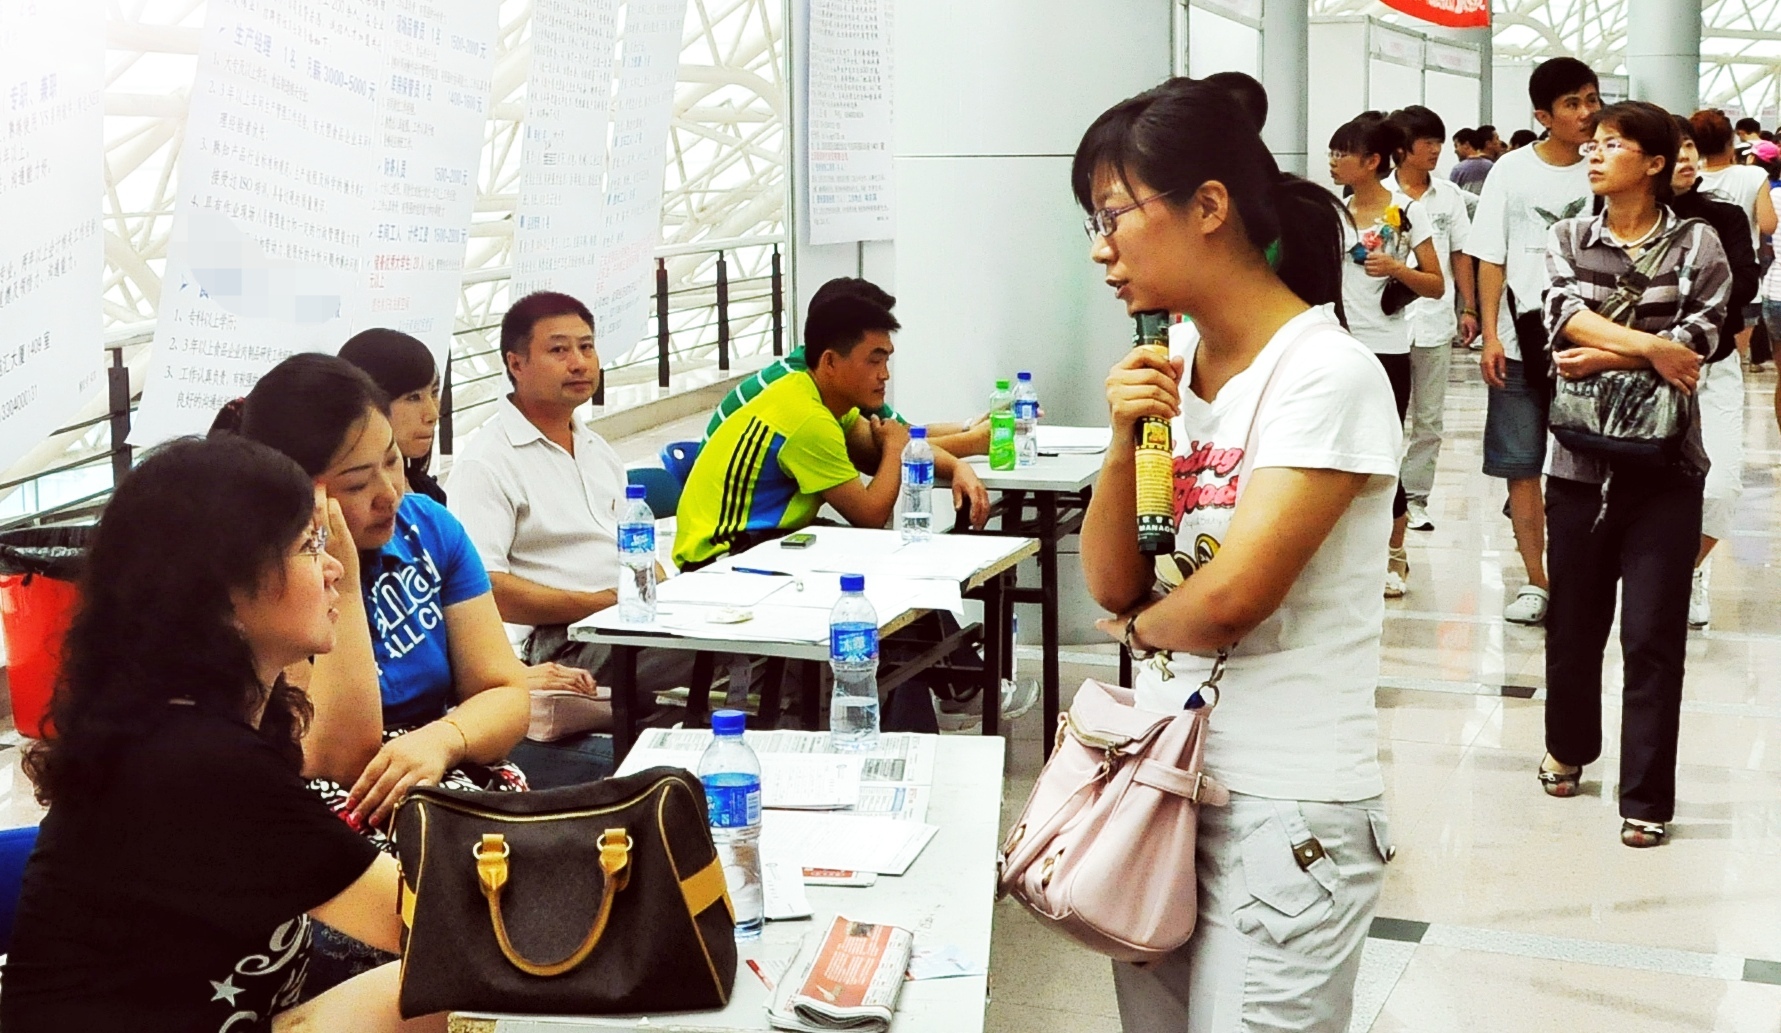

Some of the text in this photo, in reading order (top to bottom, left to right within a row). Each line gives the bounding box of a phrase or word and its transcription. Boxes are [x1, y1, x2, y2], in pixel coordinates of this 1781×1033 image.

[234, 23, 272, 58] 生产经理
[284, 46, 296, 70] 1名
